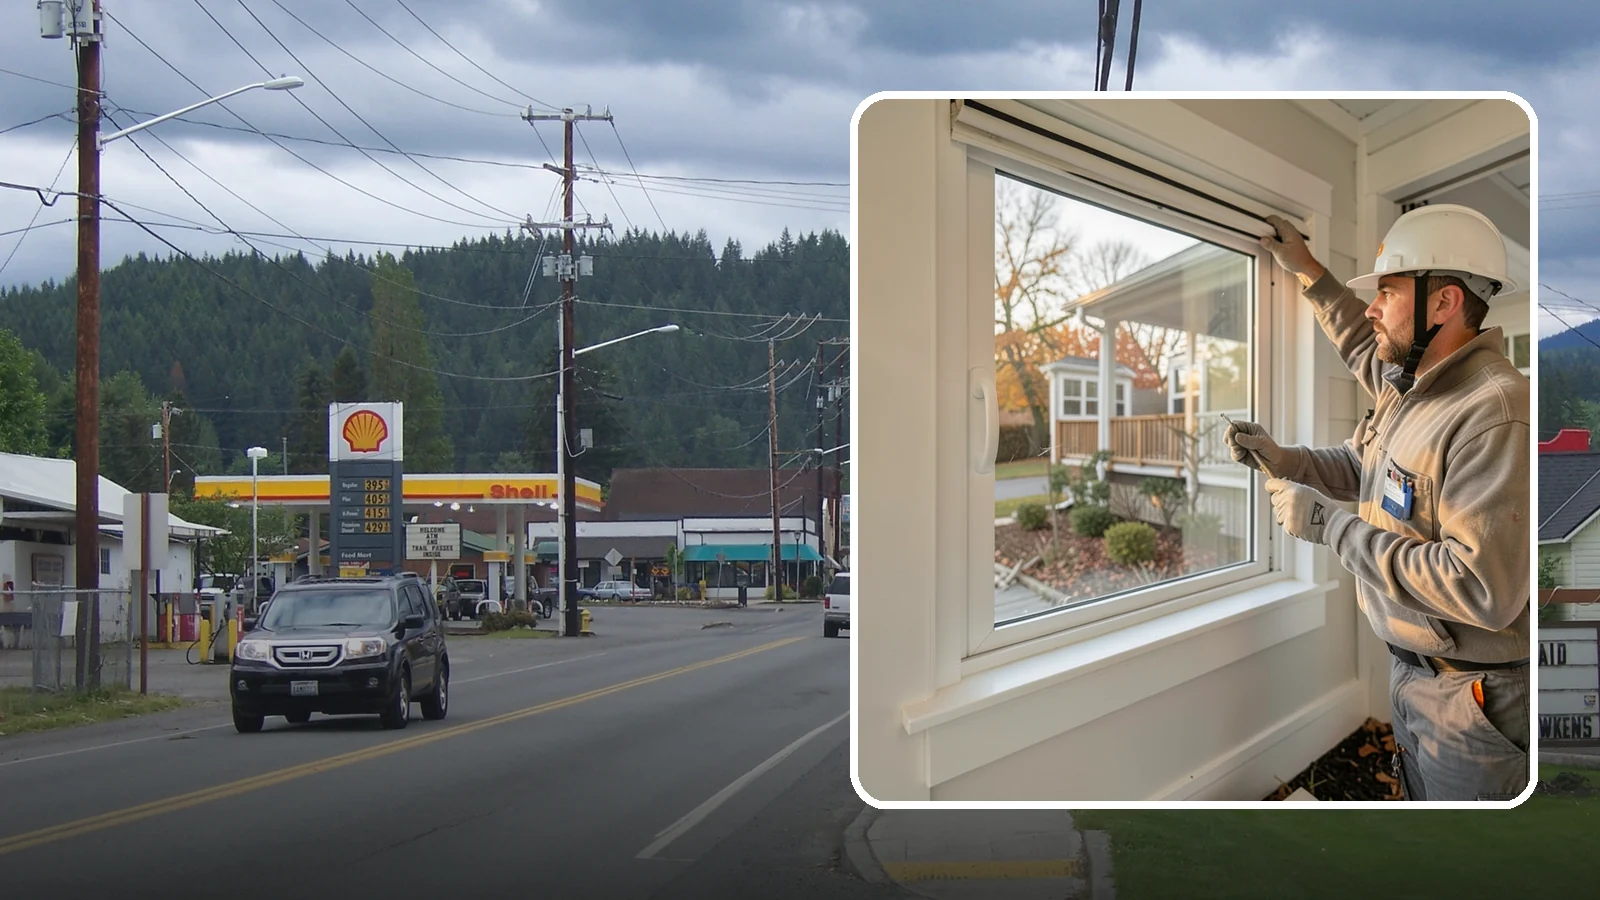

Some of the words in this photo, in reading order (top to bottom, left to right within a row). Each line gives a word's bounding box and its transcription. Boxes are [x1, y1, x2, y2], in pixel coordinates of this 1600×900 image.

[366, 480, 383, 490] 395
[490, 484, 547, 499] Shell
[366, 494, 383, 504] 405
[366, 508, 383, 518] 415
[366, 522, 383, 532] 429
[1539, 643, 1566, 666] AID
